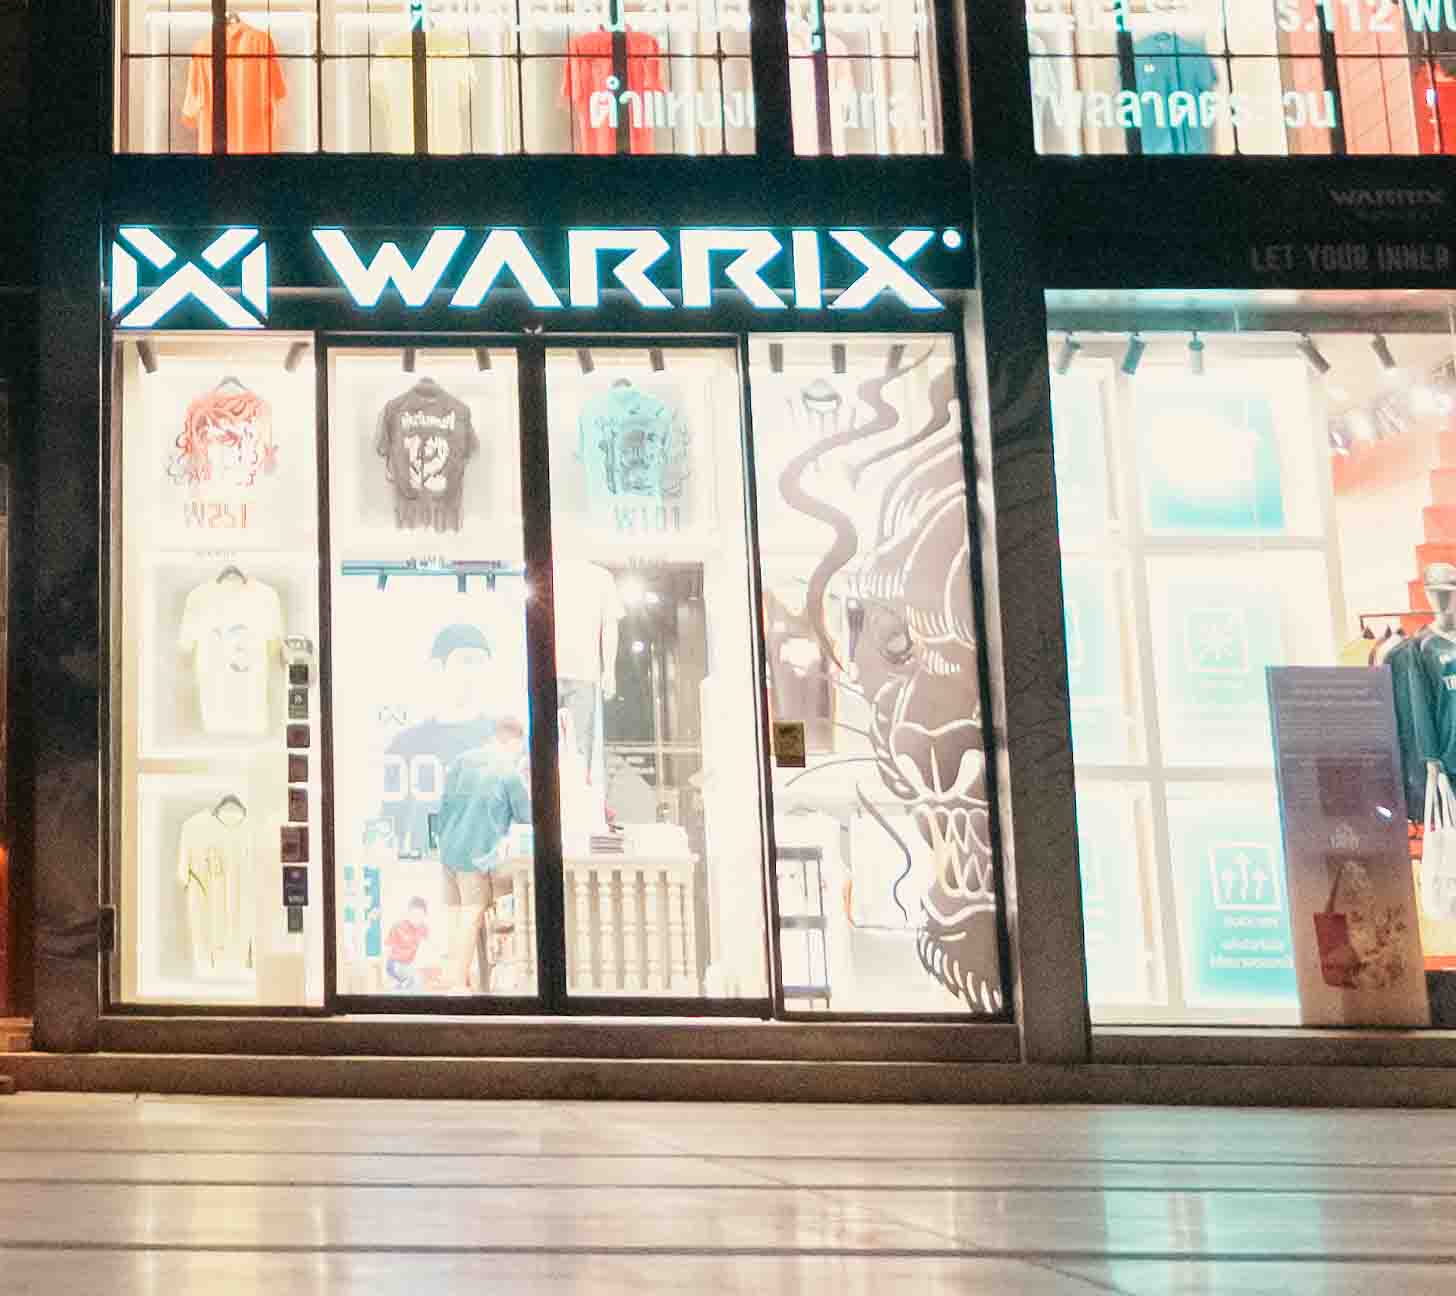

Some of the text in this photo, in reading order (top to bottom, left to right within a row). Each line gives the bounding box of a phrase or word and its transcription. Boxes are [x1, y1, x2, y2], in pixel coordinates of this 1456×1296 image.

[311, 225, 945, 310] WARRIX
[1250, 245, 1296, 273] LET
[1305, 245, 1370, 273] YOUR
[1377, 245, 1450, 273] INNER
